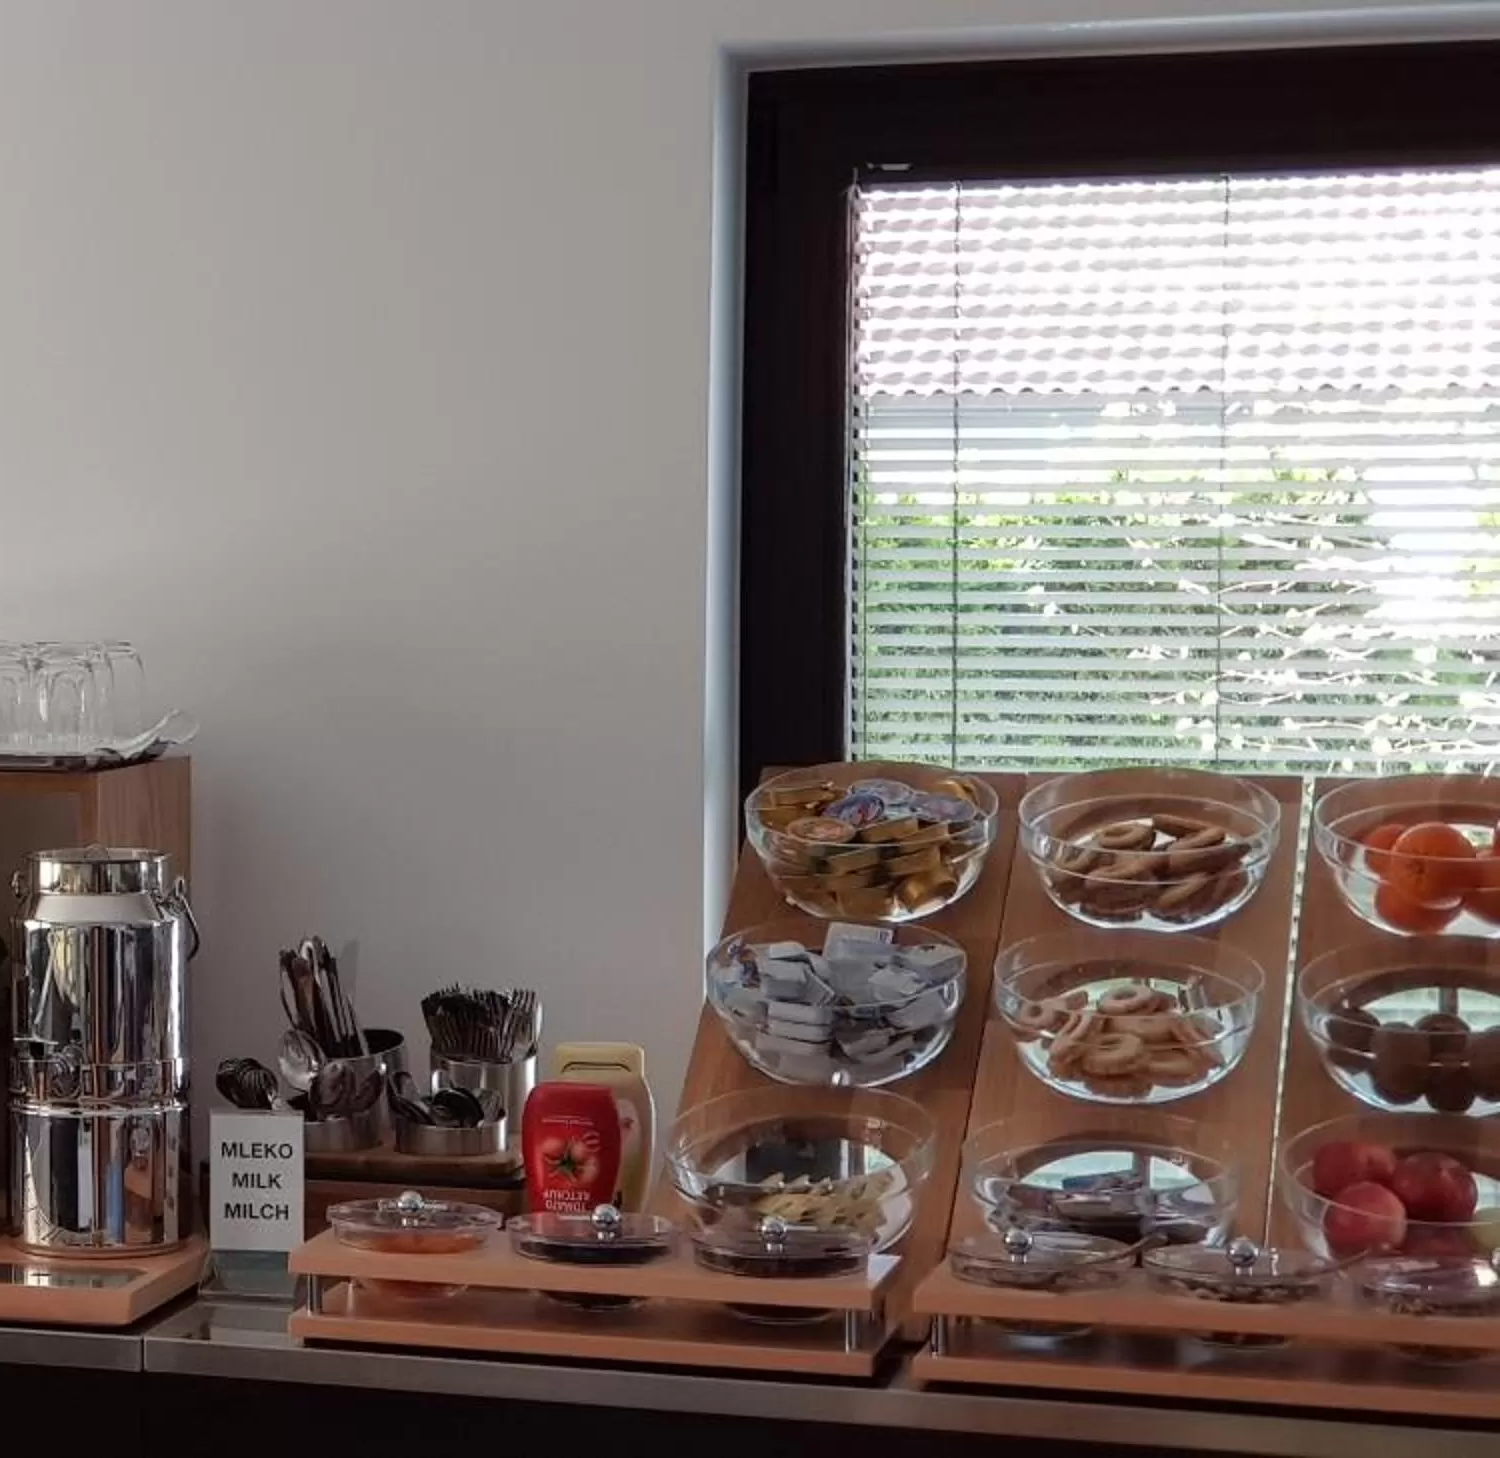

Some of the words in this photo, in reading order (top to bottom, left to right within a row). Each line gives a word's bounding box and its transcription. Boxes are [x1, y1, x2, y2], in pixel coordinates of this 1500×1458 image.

[221, 1142, 293, 1159] MLEKO
[232, 1172, 282, 1189] MILK
[543, 1188, 591, 1201] KETCHUP
[224, 1203, 289, 1220] MILCH
[545, 1199, 587, 1213] TOMATO
